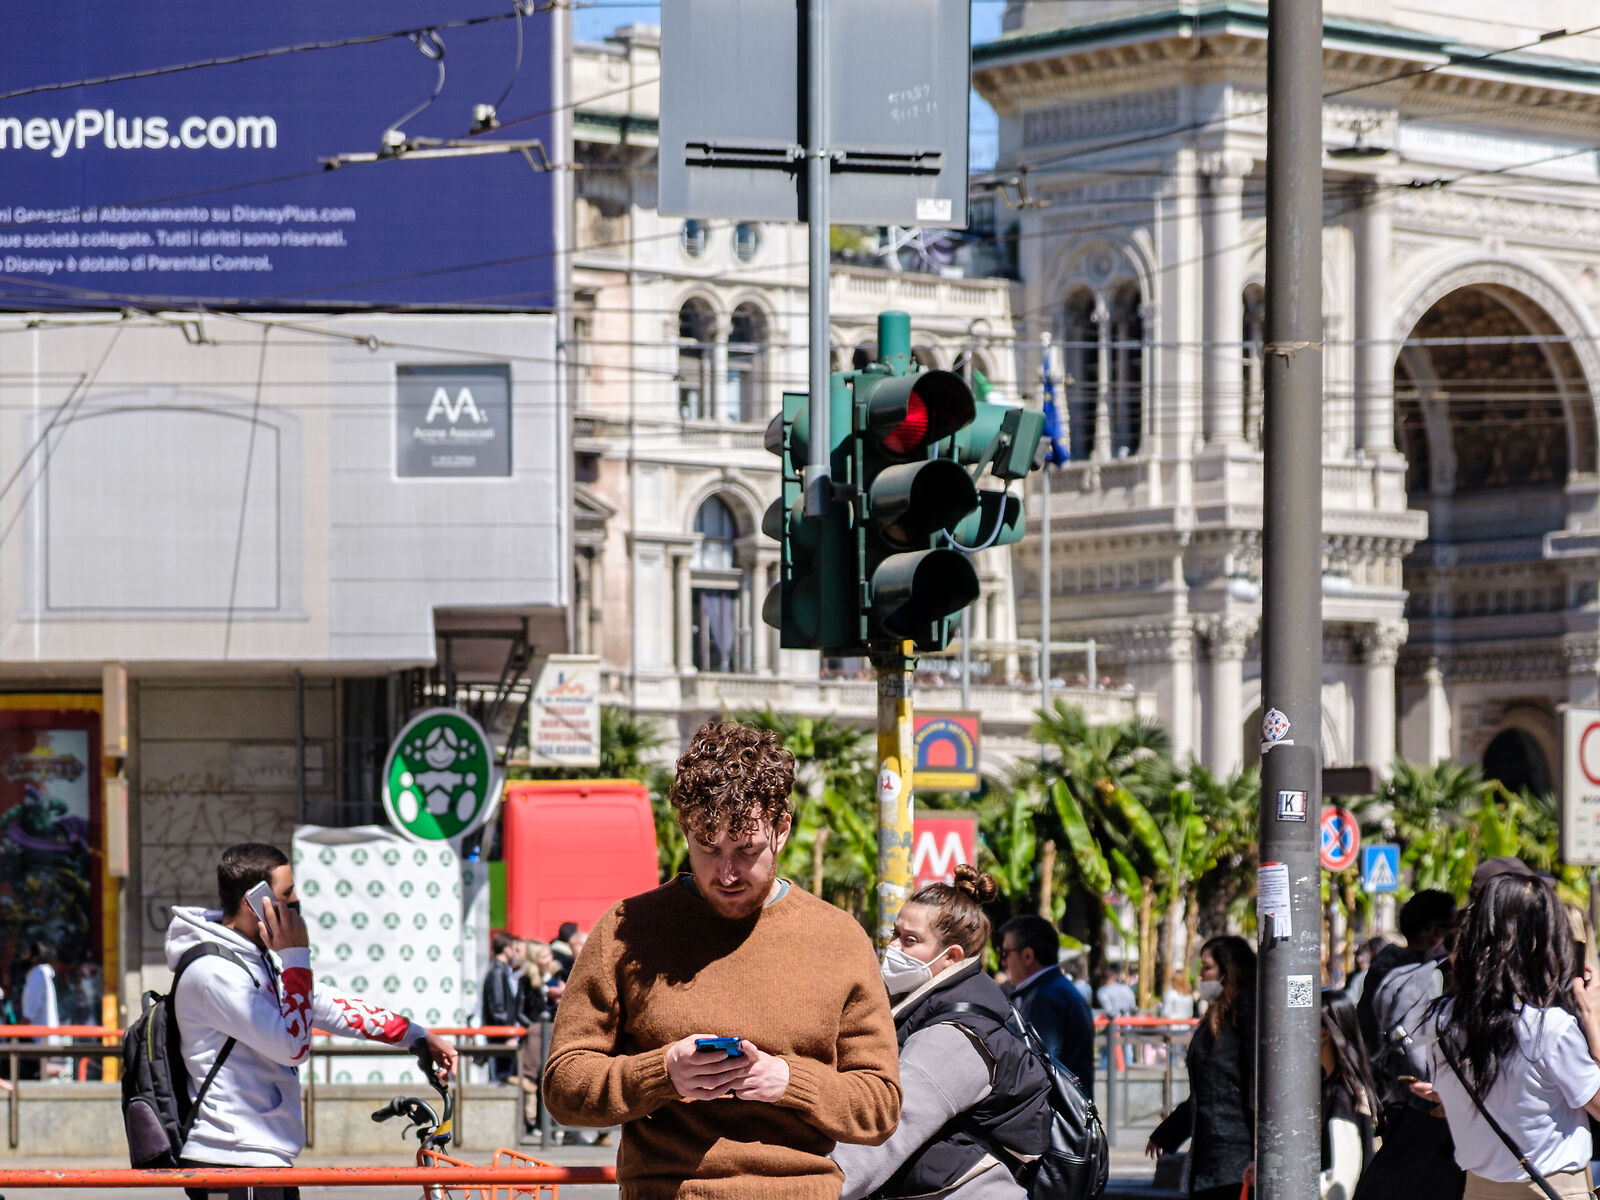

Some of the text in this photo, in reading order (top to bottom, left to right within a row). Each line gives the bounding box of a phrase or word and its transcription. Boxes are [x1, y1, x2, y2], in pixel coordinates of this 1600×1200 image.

[0, 109, 277, 158] neyPlus.com
[100, 206, 209, 223] Abbonamento
[210, 207, 231, 222] su
[231, 204, 356, 225] DisneyPlus.com
[23, 230, 80, 248] società
[156, 229, 191, 247] Tutti
[199, 229, 241, 247] diritti
[241, 232, 280, 247] sono
[281, 229, 348, 247] riservati.
[4, 253, 273, 275] Disney+ è dotato di Parental Control.
[1284, 794, 1295, 812] K
